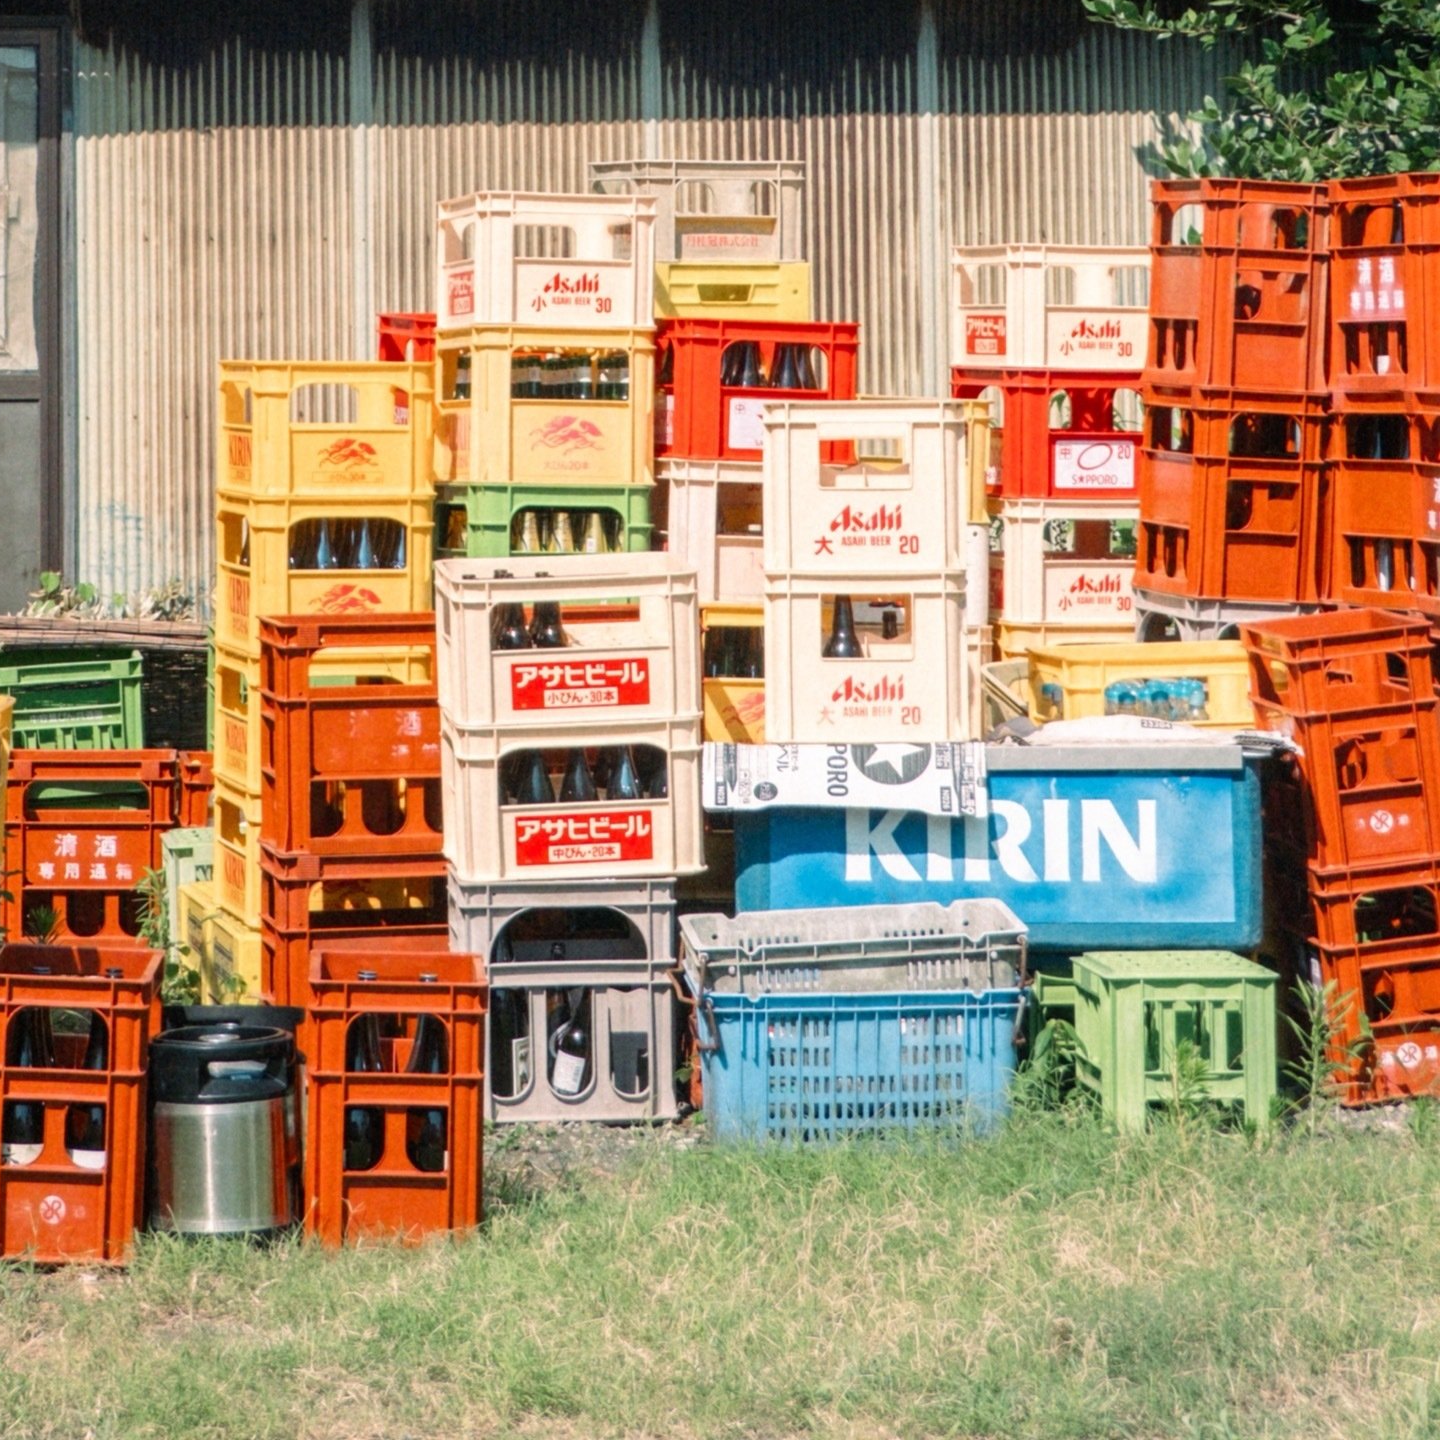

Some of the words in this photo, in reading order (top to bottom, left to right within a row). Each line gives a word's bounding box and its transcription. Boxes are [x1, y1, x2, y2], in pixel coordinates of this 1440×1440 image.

[545, 273, 599, 294] Asahi
[531, 296, 547, 312] 小
[596, 298, 612, 313] 30
[1071, 319, 1121, 338] Asahi
[1061, 341, 1074, 357] 小
[1118, 343, 1132, 357] 30
[1118, 444, 1131, 459] 20
[830, 504, 901, 532] Asahi
[814, 535, 834, 555] 大
[841, 536, 866, 546] ASAHI
[871, 536, 891, 546] BEER
[899, 535, 919, 554] 20
[1070, 573, 1121, 592] Asahi
[1057, 595, 1072, 611] 小
[1117, 596, 1132, 611] 30
[515, 662, 646, 689] アサヒビール
[832, 674, 904, 702] Asahi
[901, 705, 921, 724] 20
[517, 816, 650, 842] アサヒビール
[54, 832, 117, 857] 清酒
[846, 799, 1157, 882] KIRIN
